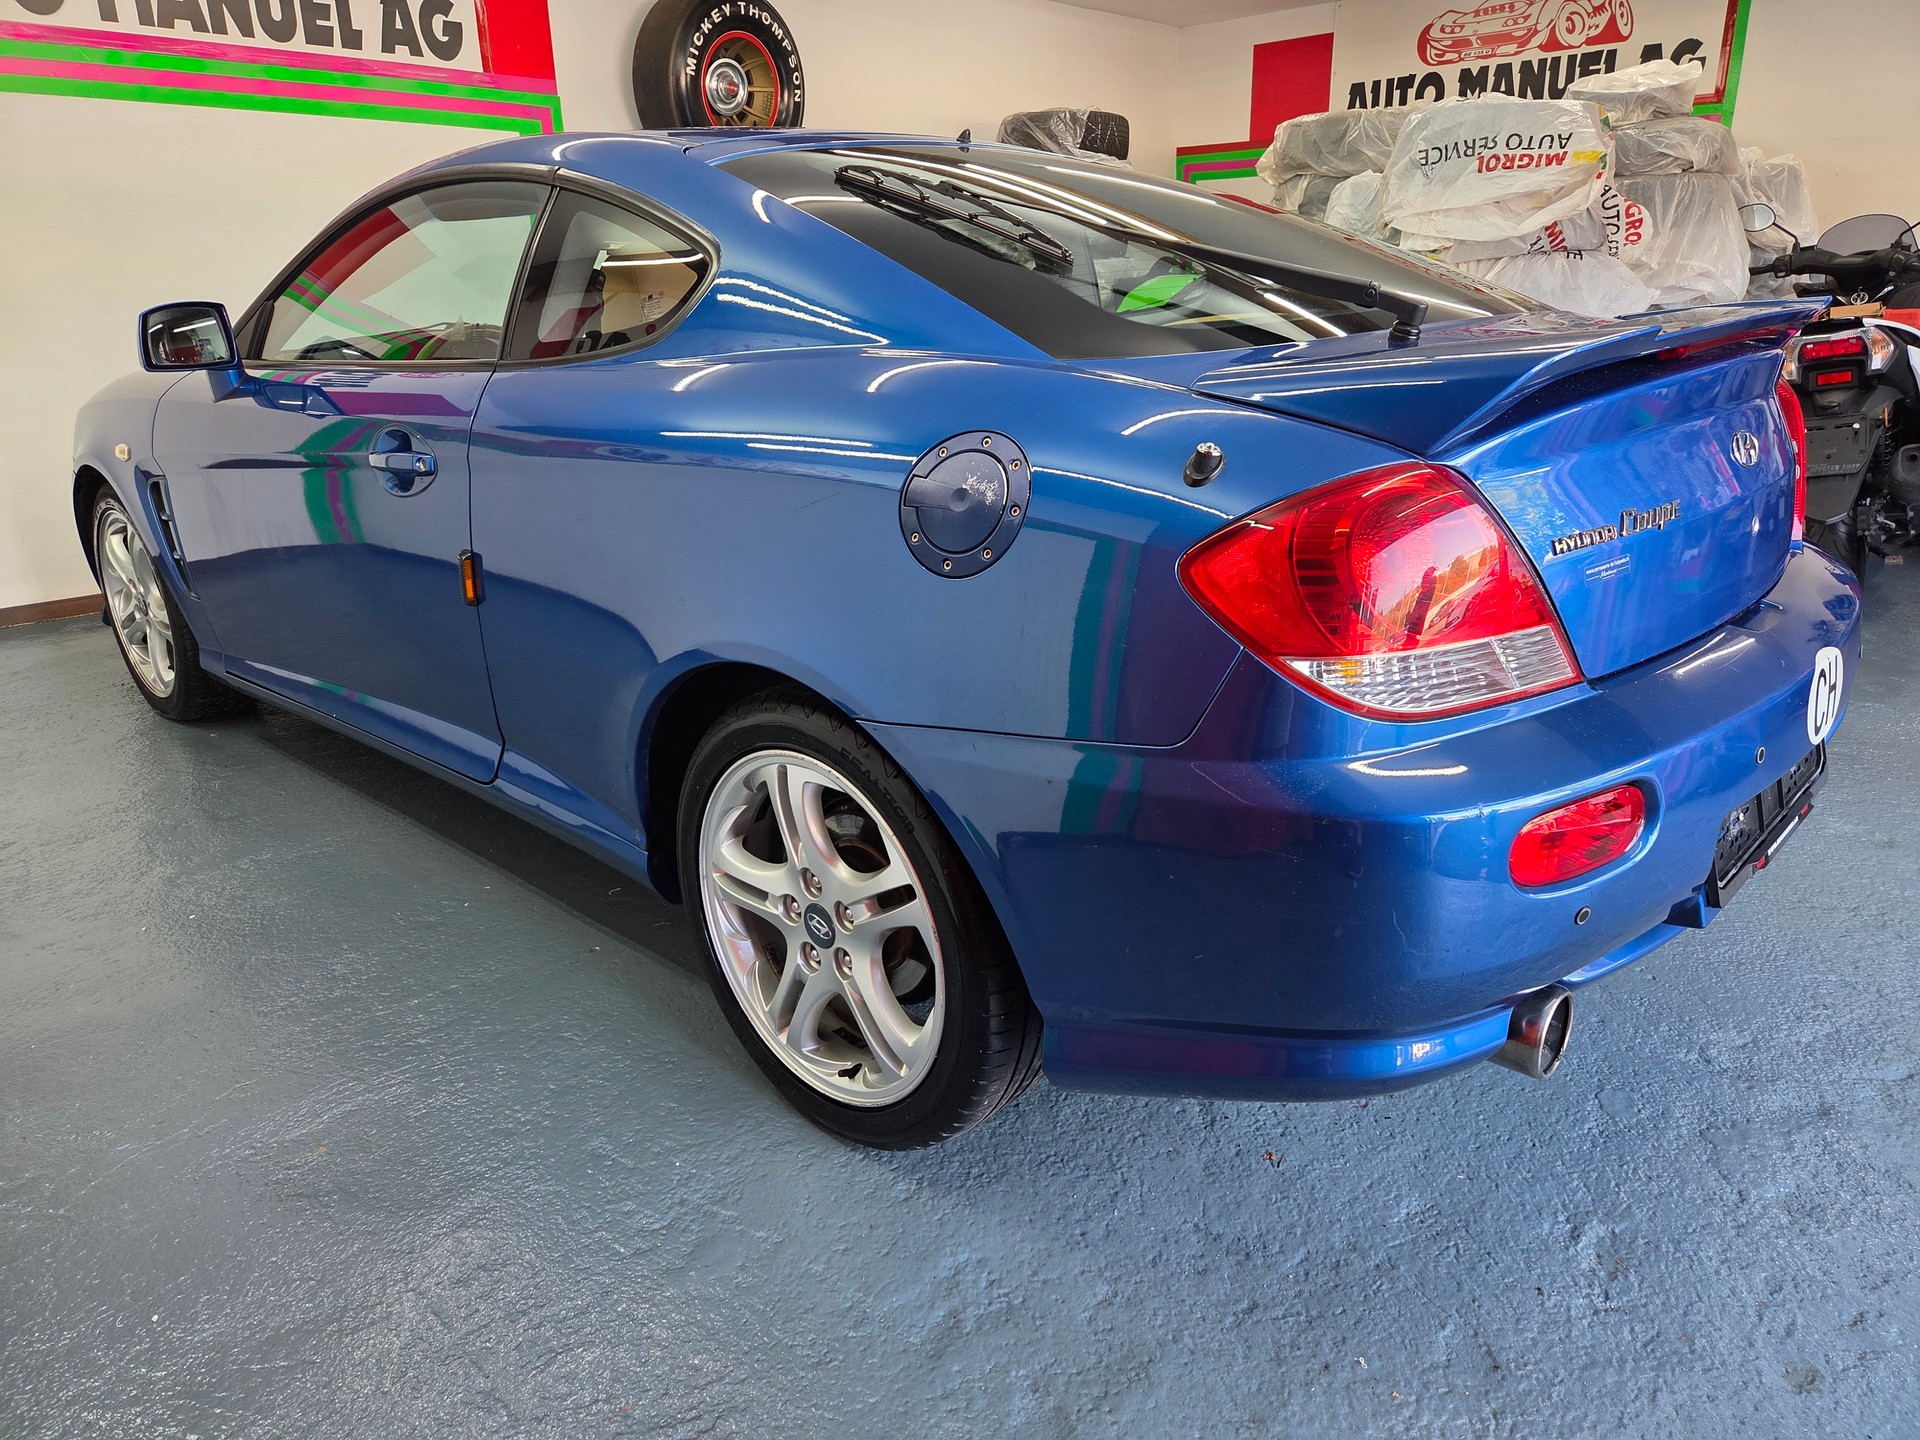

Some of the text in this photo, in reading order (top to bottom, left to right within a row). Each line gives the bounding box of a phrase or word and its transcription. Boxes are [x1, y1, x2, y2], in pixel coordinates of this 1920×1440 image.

[381, 0, 463, 61] AG
[685, 1, 802, 102] MICKEY THOMPSON
[1346, 71, 1445, 110] AUTO
[1418, 131, 1574, 167] AUTO SERVICE
[1475, 150, 1568, 174] MIGROL
[1551, 524, 1618, 556] HYUNDAI
[1813, 654, 1838, 737] CH
